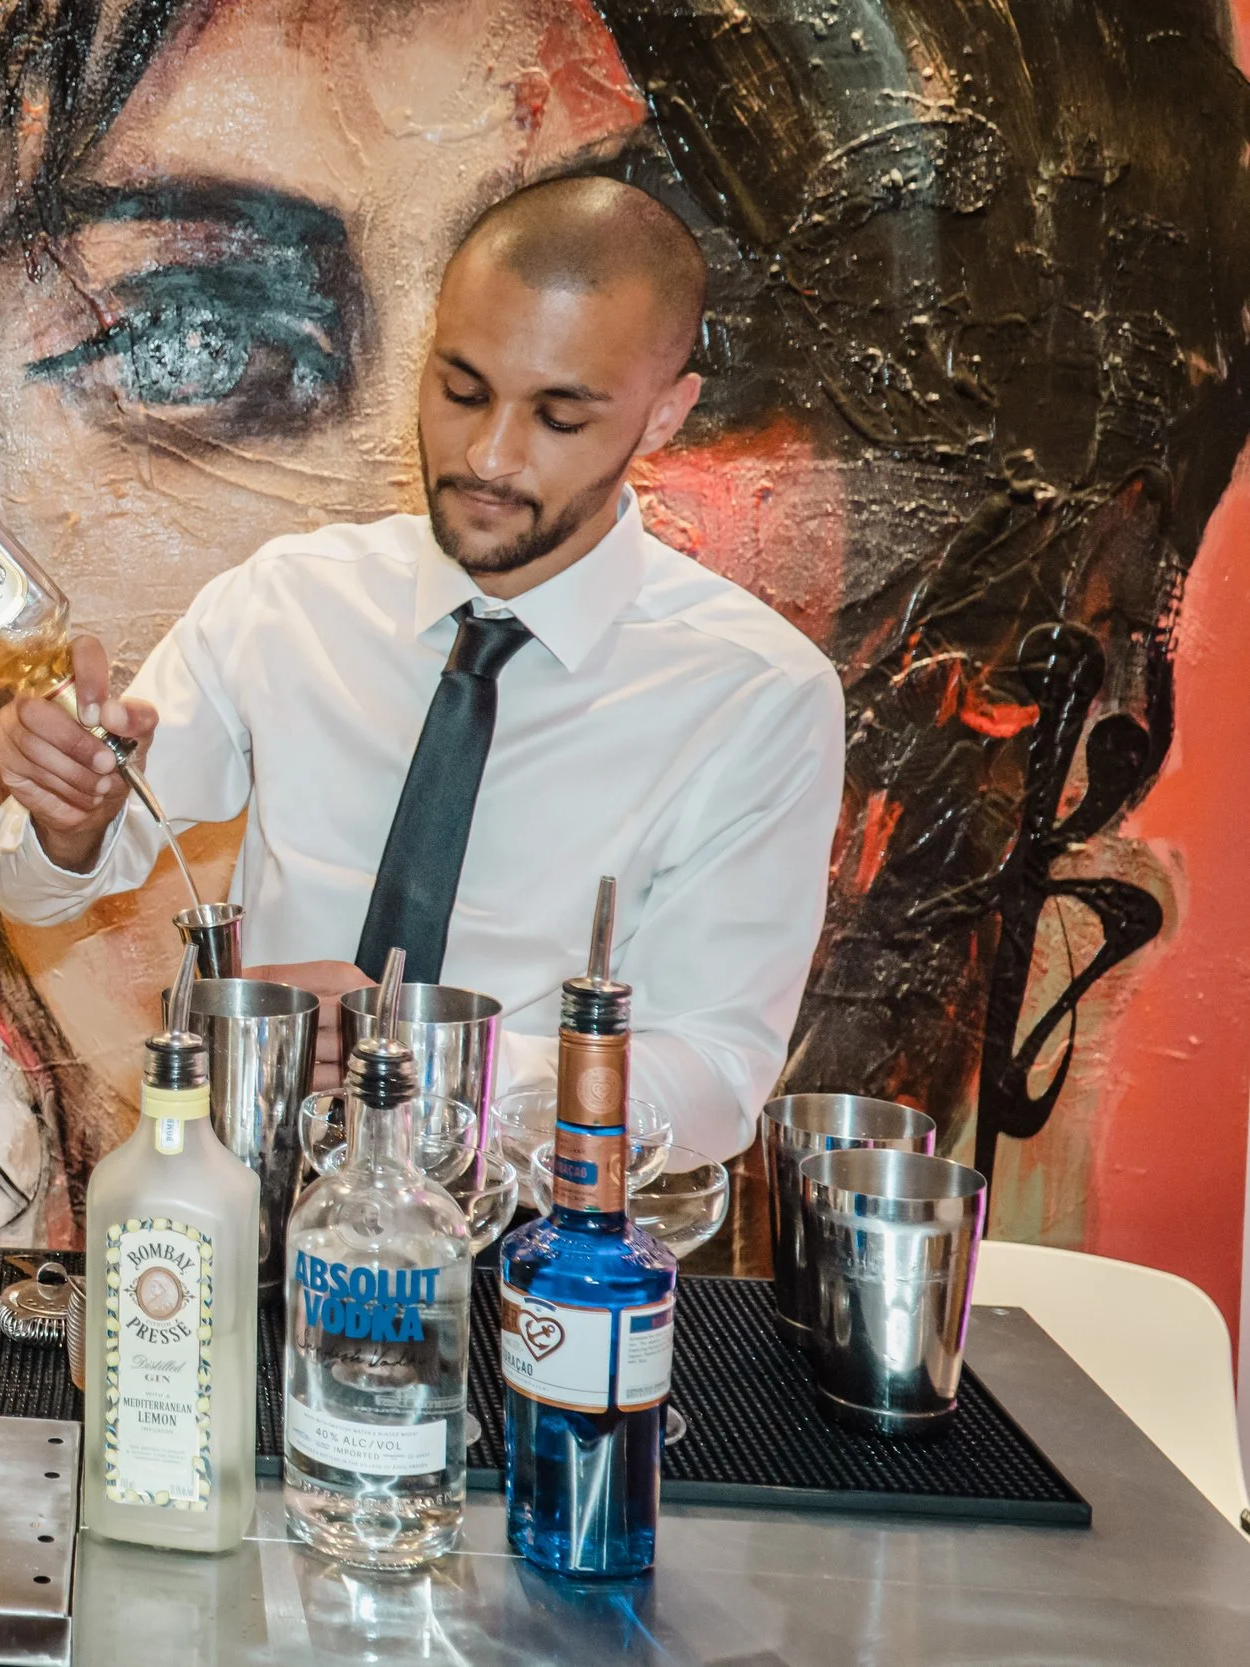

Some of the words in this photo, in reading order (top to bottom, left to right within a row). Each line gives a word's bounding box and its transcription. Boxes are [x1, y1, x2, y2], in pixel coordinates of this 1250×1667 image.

[126, 1243, 196, 1276] BOMBAY
[294, 1249, 440, 1305] ABSOLUT
[304, 1288, 425, 1342] VODKA
[126, 1316, 192, 1344] PRESSÉ
[131, 1354, 187, 1374] Distilled
[145, 1374, 171, 1383] GIN
[123, 1397, 192, 1414] MEDITERRANEAN
[138, 1411, 177, 1426] LEMON
[315, 1427, 339, 1442] 40%
[334, 1446, 380, 1460] IMPORTED
